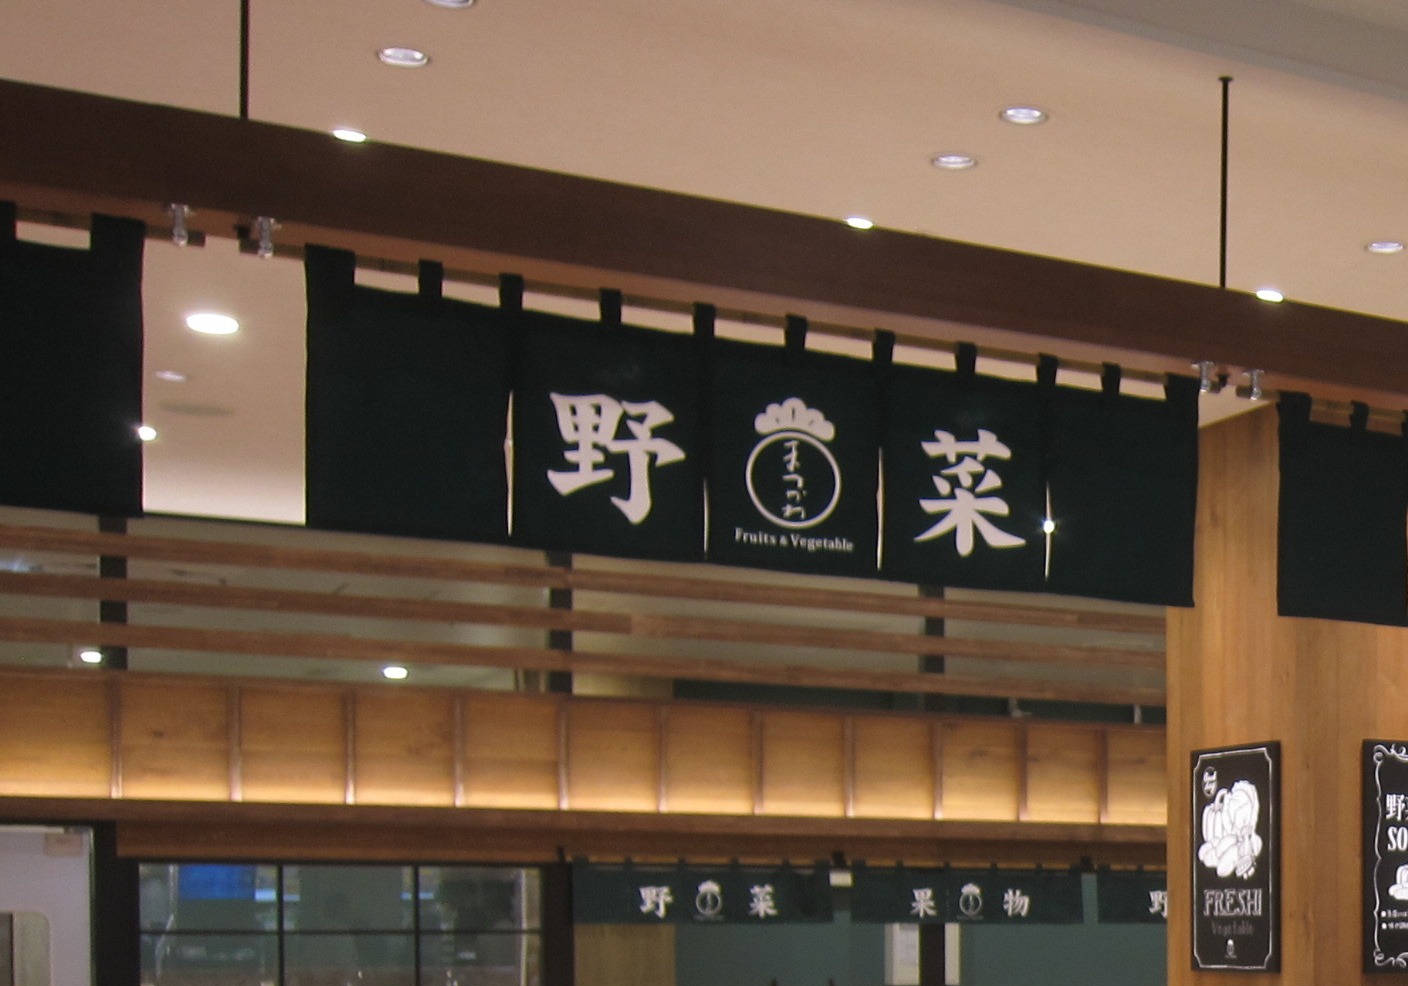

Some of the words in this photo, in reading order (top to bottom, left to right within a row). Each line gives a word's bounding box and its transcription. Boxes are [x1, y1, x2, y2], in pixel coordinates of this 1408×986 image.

[548, 393, 686, 524] 野
[915, 429, 1026, 557] 菜
[781, 439, 808, 521] まつかわ
[734, 527, 777, 545] Fruits
[790, 533, 854, 552] Vegetable
[639, 886, 674, 919] 野
[749, 884, 779, 918] 菜
[911, 887, 937, 918] 果
[1003, 888, 1031, 917] 物
